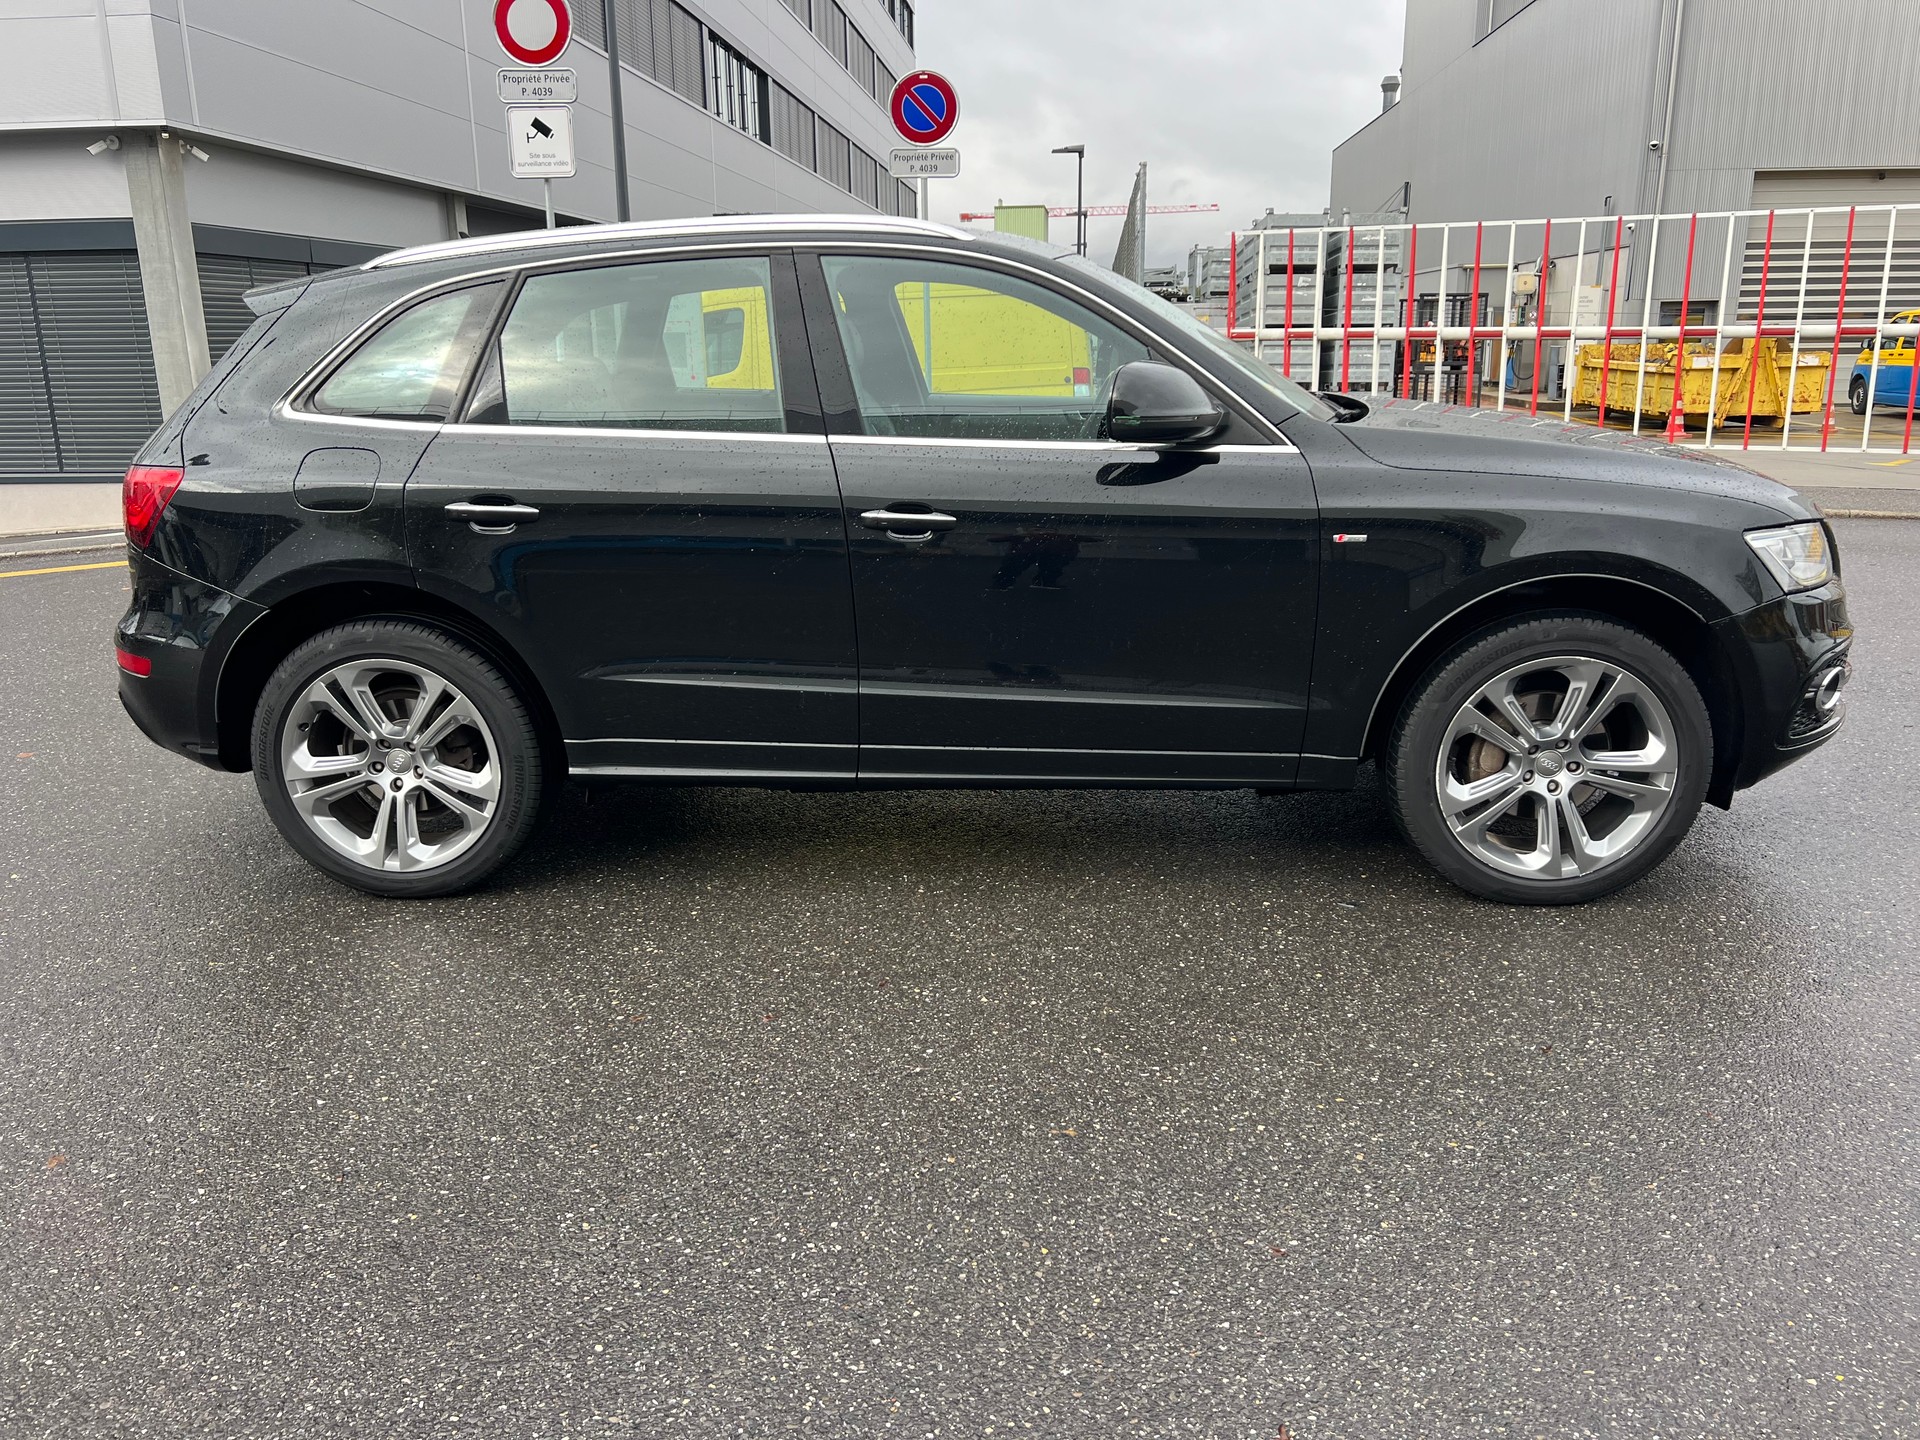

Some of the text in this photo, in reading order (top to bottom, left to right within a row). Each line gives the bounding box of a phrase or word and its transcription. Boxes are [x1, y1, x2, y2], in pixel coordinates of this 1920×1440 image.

[502, 74, 570, 85] Propriété Privée
[521, 87, 553, 97] P. 4039
[894, 153, 954, 163] Propriété Privée
[910, 164, 938, 173] P. 4039
[258, 702, 275, 781] BRIDGESTONE
